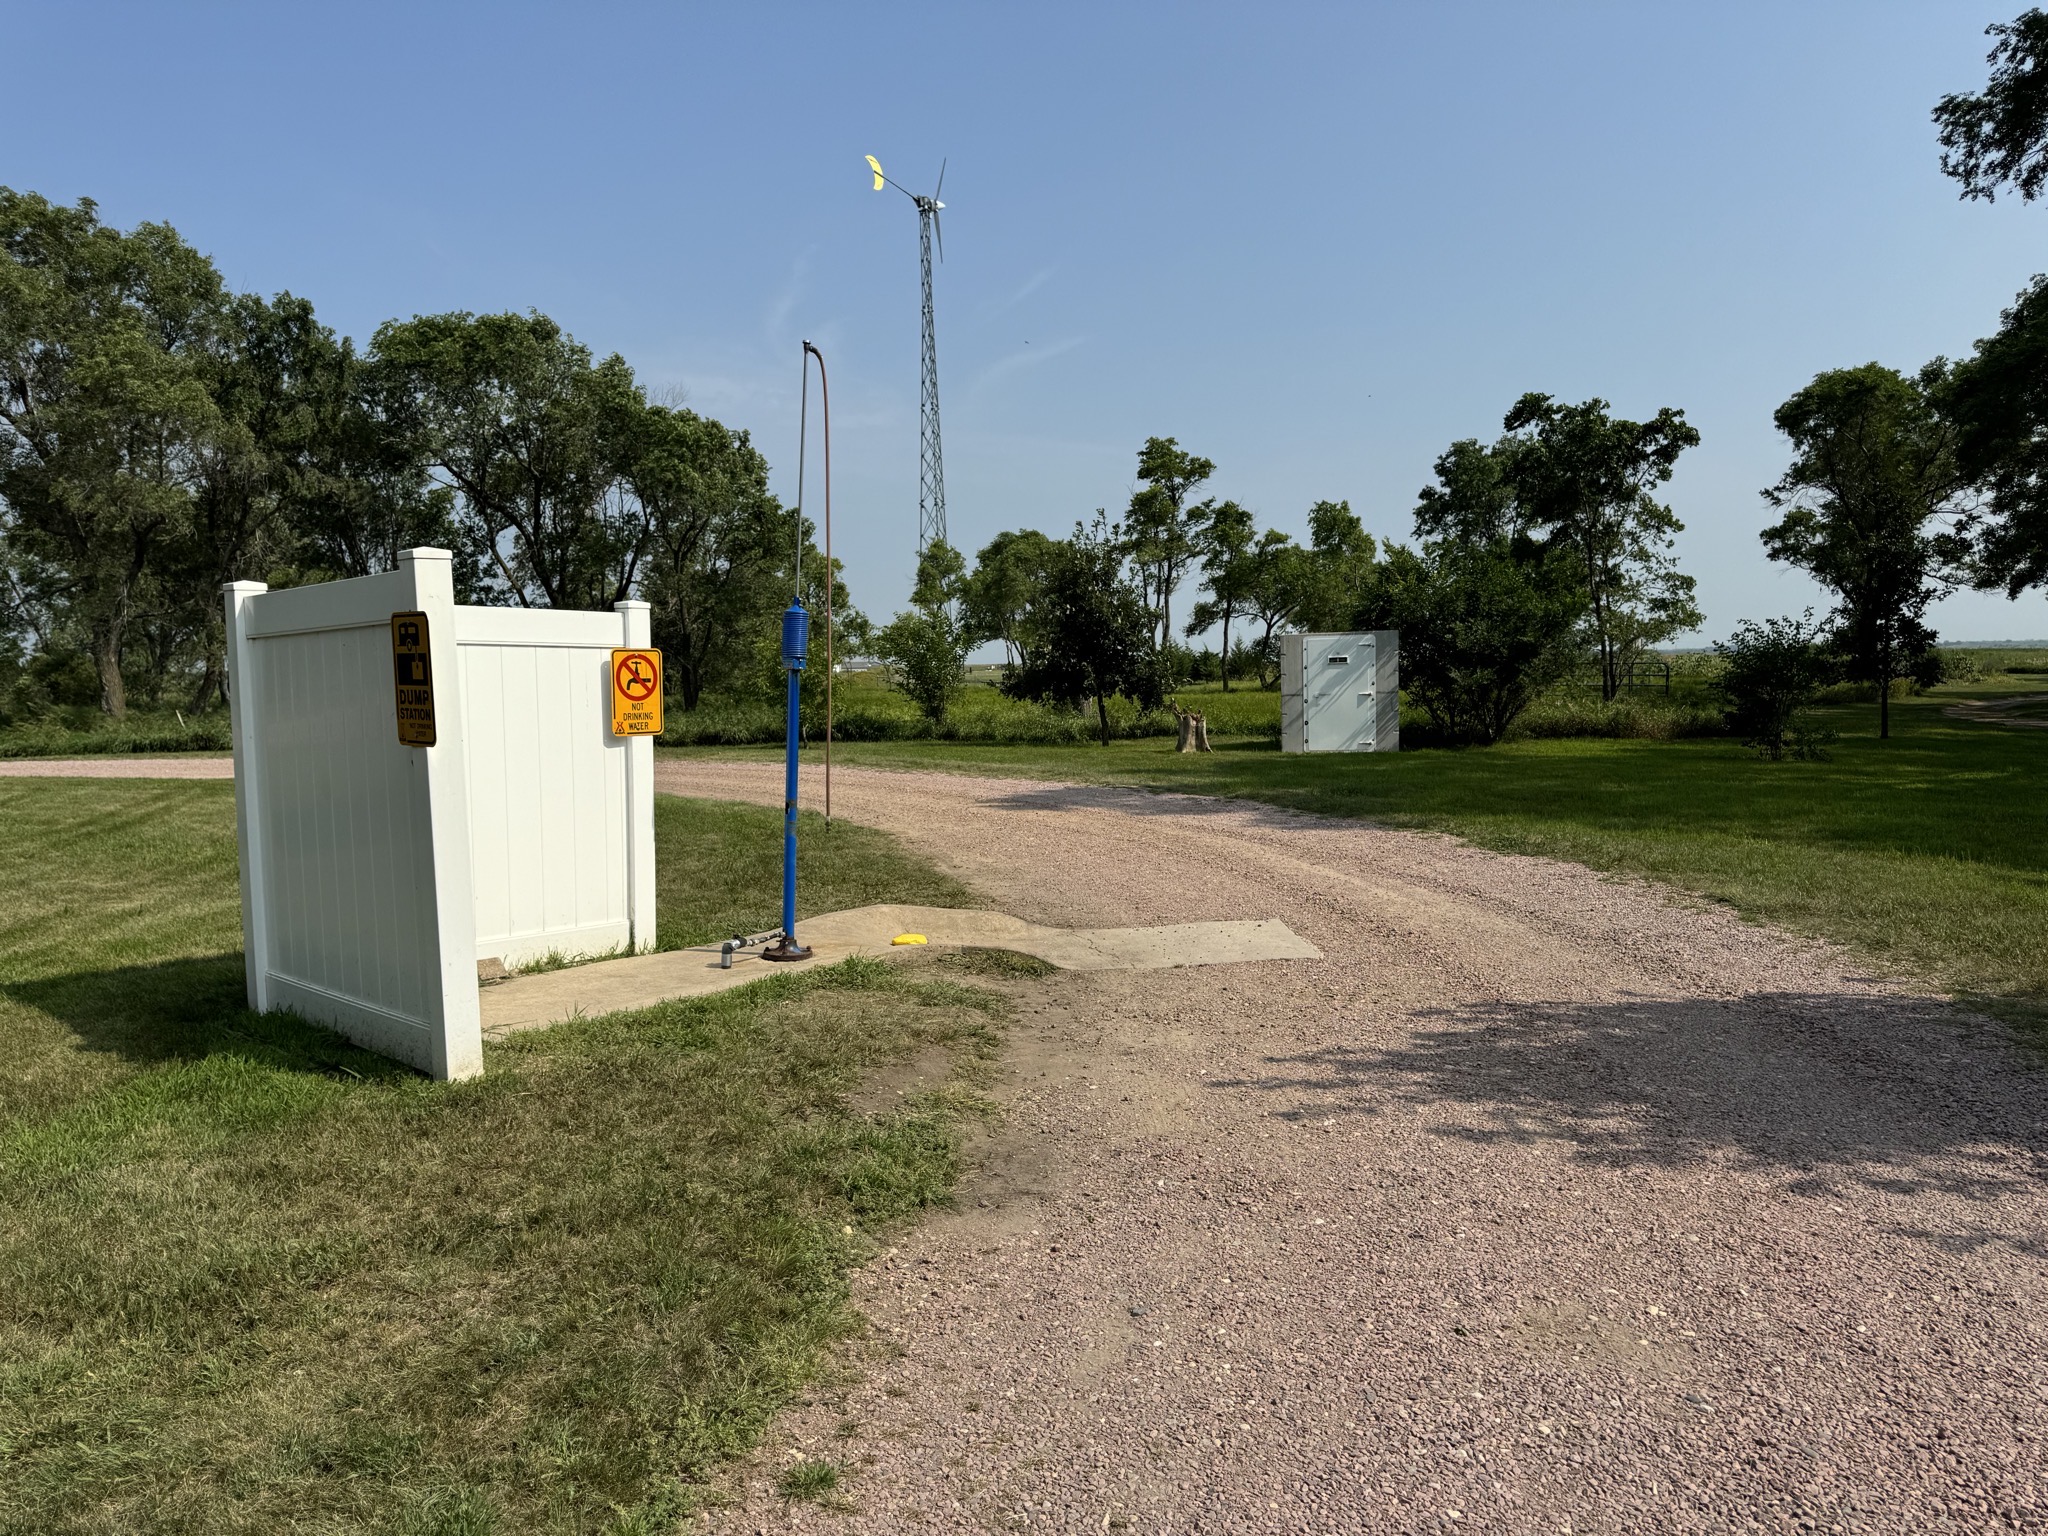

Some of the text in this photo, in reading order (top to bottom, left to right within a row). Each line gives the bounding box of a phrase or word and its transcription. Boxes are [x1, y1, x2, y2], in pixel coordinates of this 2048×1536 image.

[400, 690, 429, 705] DUMP
[631, 703, 644, 711] NOT
[400, 708, 431, 721] STATION
[623, 712, 654, 721] DRINKING
[628, 722, 649, 730] WATER
